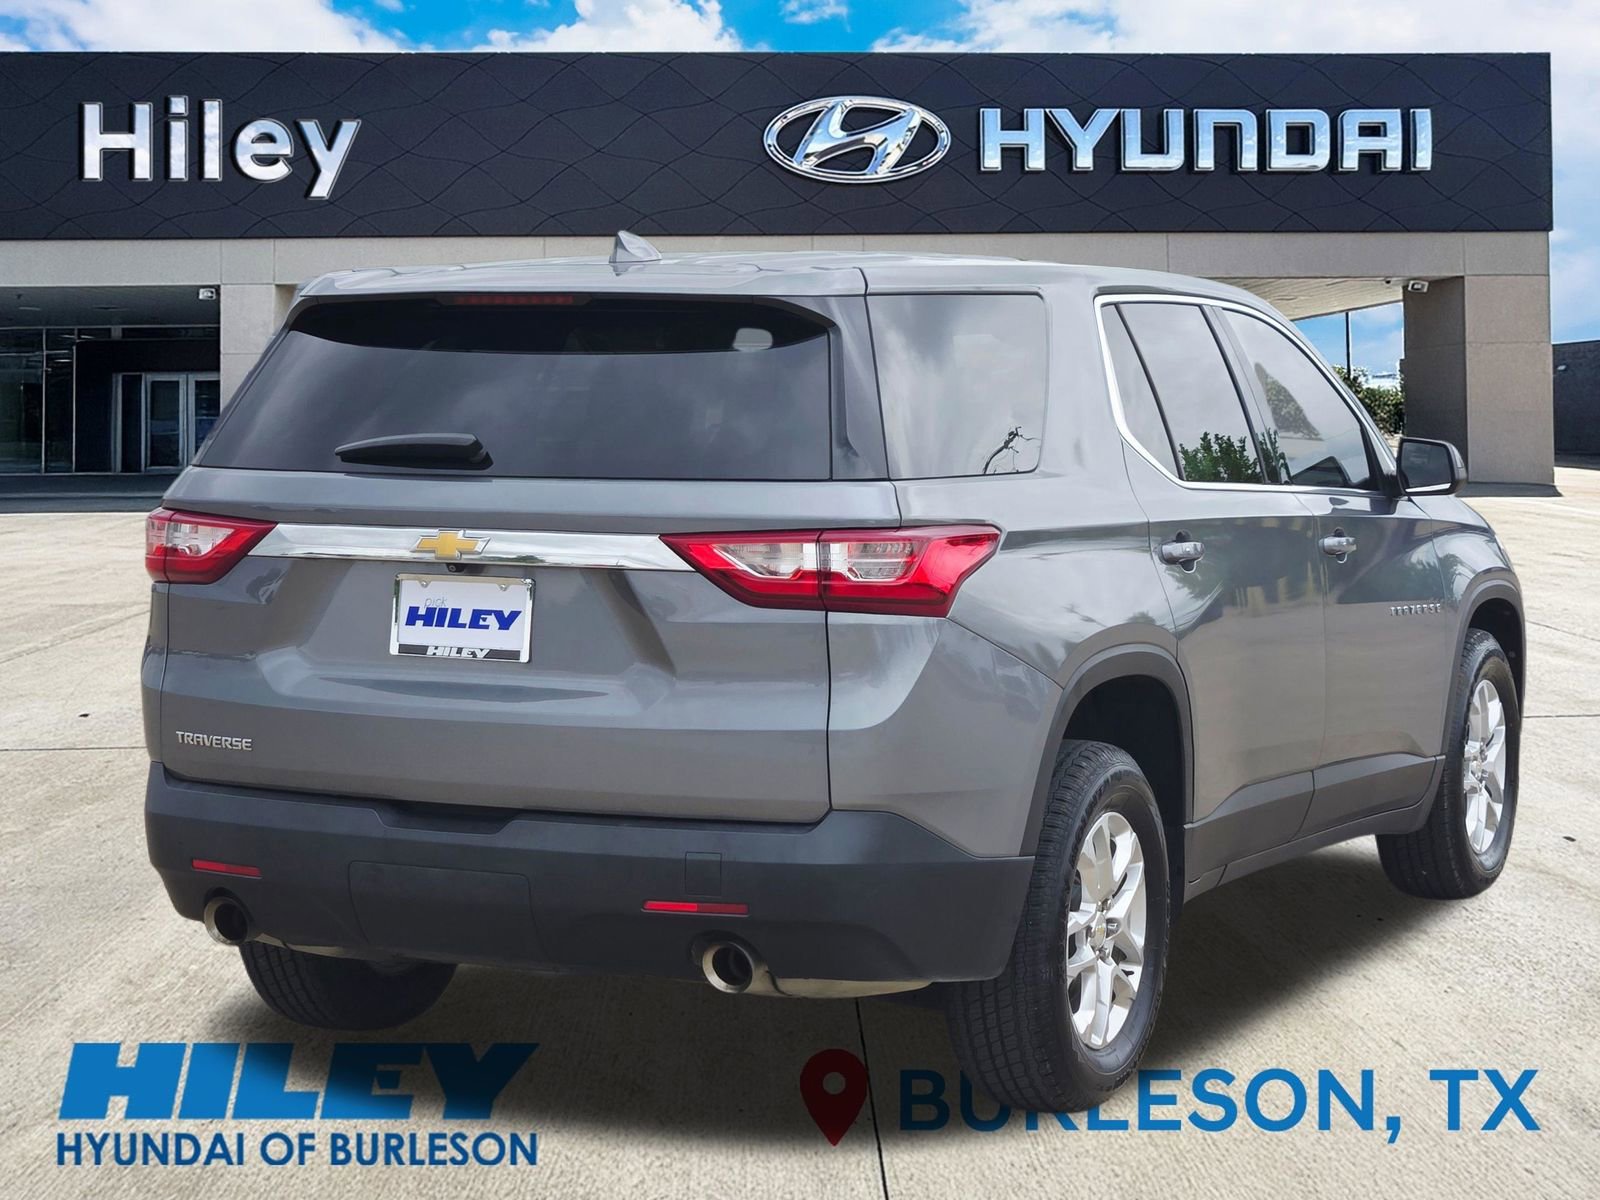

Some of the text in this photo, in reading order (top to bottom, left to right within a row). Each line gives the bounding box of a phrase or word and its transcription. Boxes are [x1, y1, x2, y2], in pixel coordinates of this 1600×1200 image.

[81, 95, 361, 199] Hiley
[980, 108, 1432, 171] HYUNDAI
[405, 606, 522, 630] HILEY
[426, 646, 490, 658] HILEY
[175, 730, 253, 751] TRAVERSE
